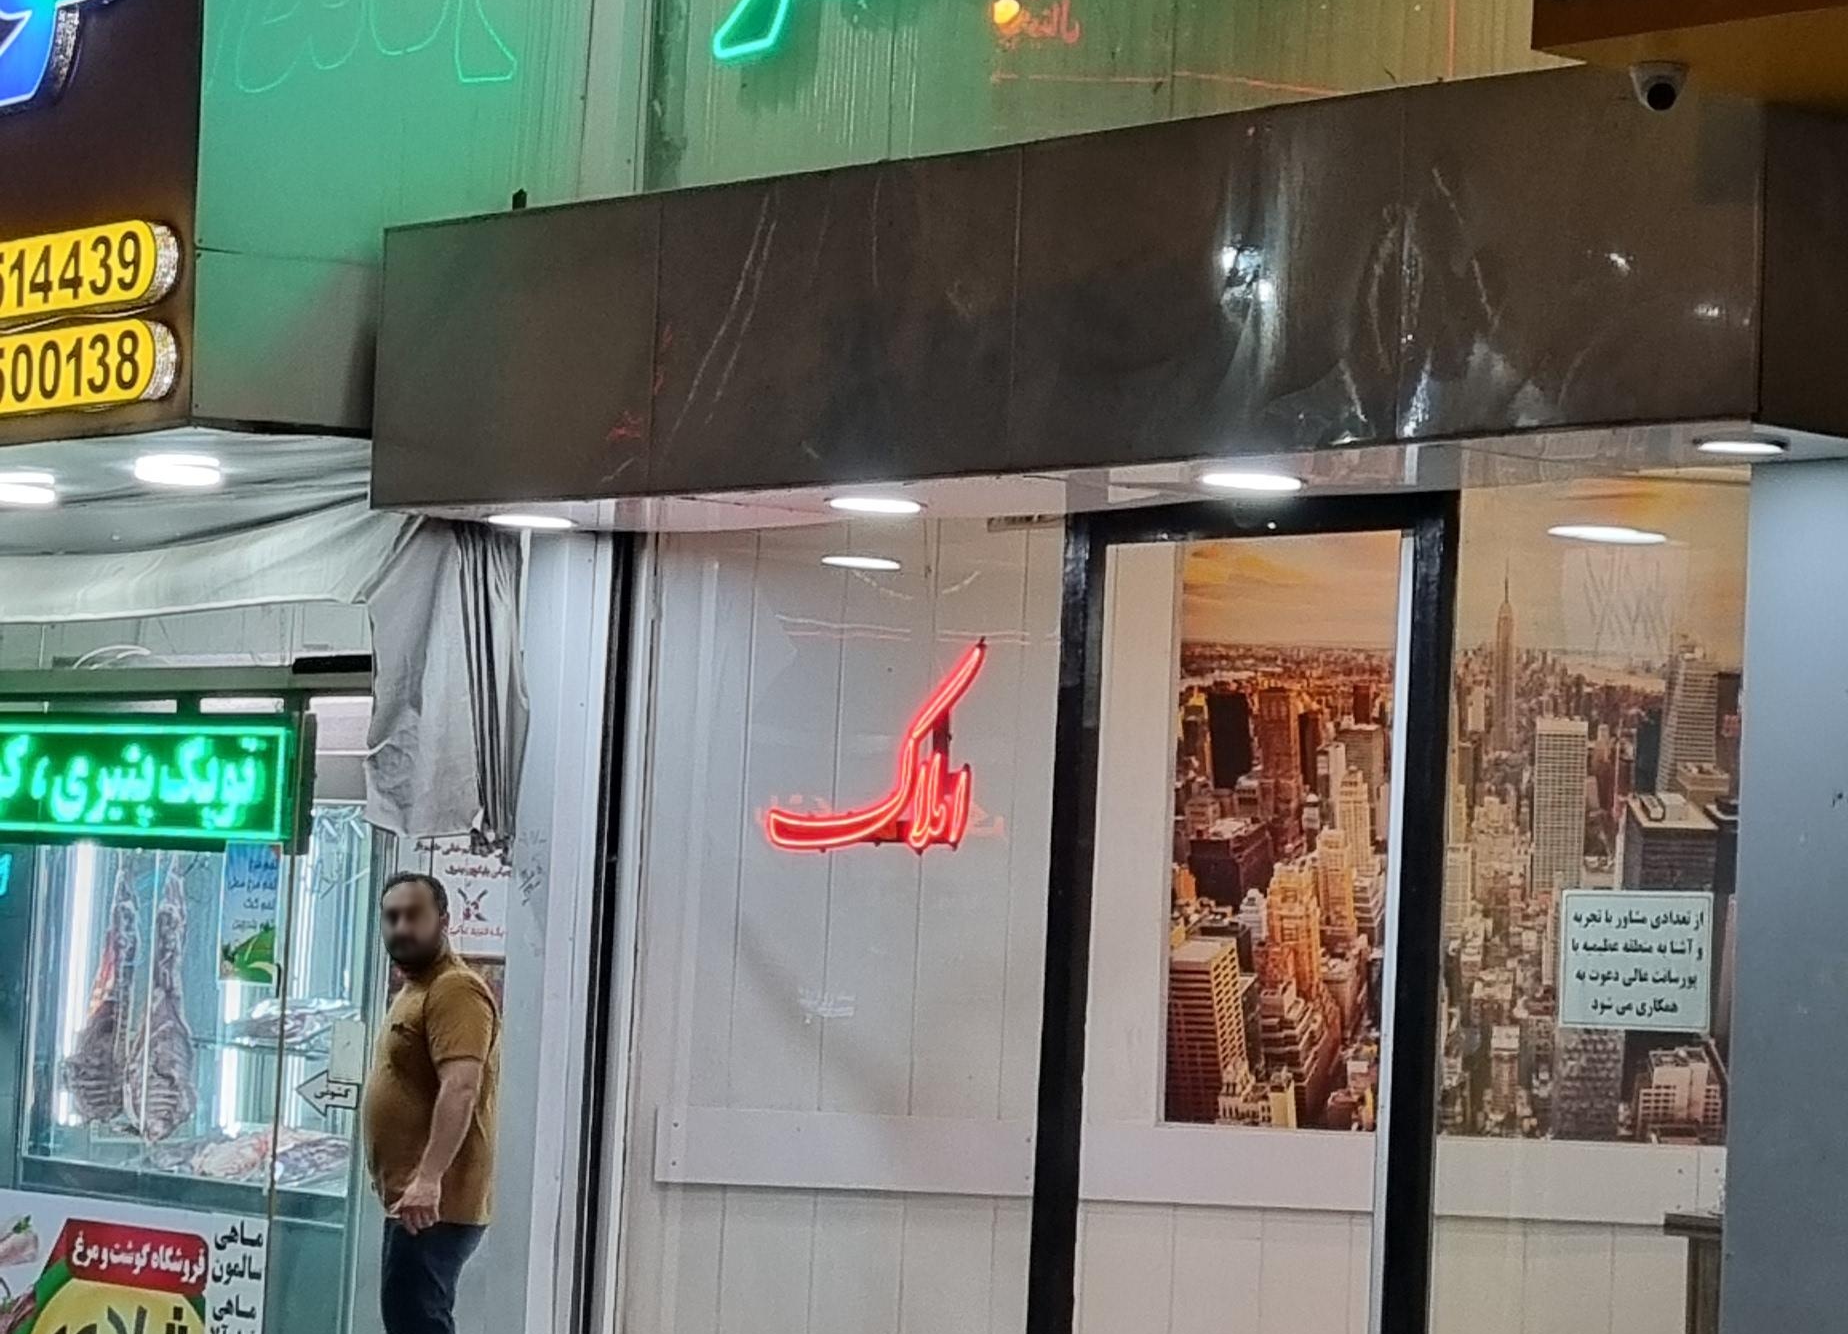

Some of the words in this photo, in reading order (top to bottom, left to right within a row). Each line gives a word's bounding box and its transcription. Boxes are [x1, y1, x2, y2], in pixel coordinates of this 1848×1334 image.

[0, 230, 141, 309] 14439
[0, 329, 140, 404] 00138
[765, 636, 986, 854] املاک
[1573, 908, 1602, 929] تجربه
[1615, 909, 1648, 929] مشاور
[1650, 910, 1692, 930] تعدادی
[1693, 910, 1704, 931] از
[1622, 938, 1653, 953] منطقه
[1669, 938, 1693, 955] آشنا
[1588, 970, 1619, 987] دعوت
[1622, 967, 1648, 987] عالی
[1590, 996, 1613, 1016] شود
[1635, 997, 1679, 1017] همکاری
[213, 1220, 264, 1251] ماهی
[71, 1229, 98, 1266] مرغ
[99, 1246, 109, 1270] و
[109, 1240, 151, 1275] گوشت
[151, 1243, 206, 1284] فروشگاه
[211, 1253, 262, 1286] سالمون
[213, 1294, 257, 1322] ماهی
